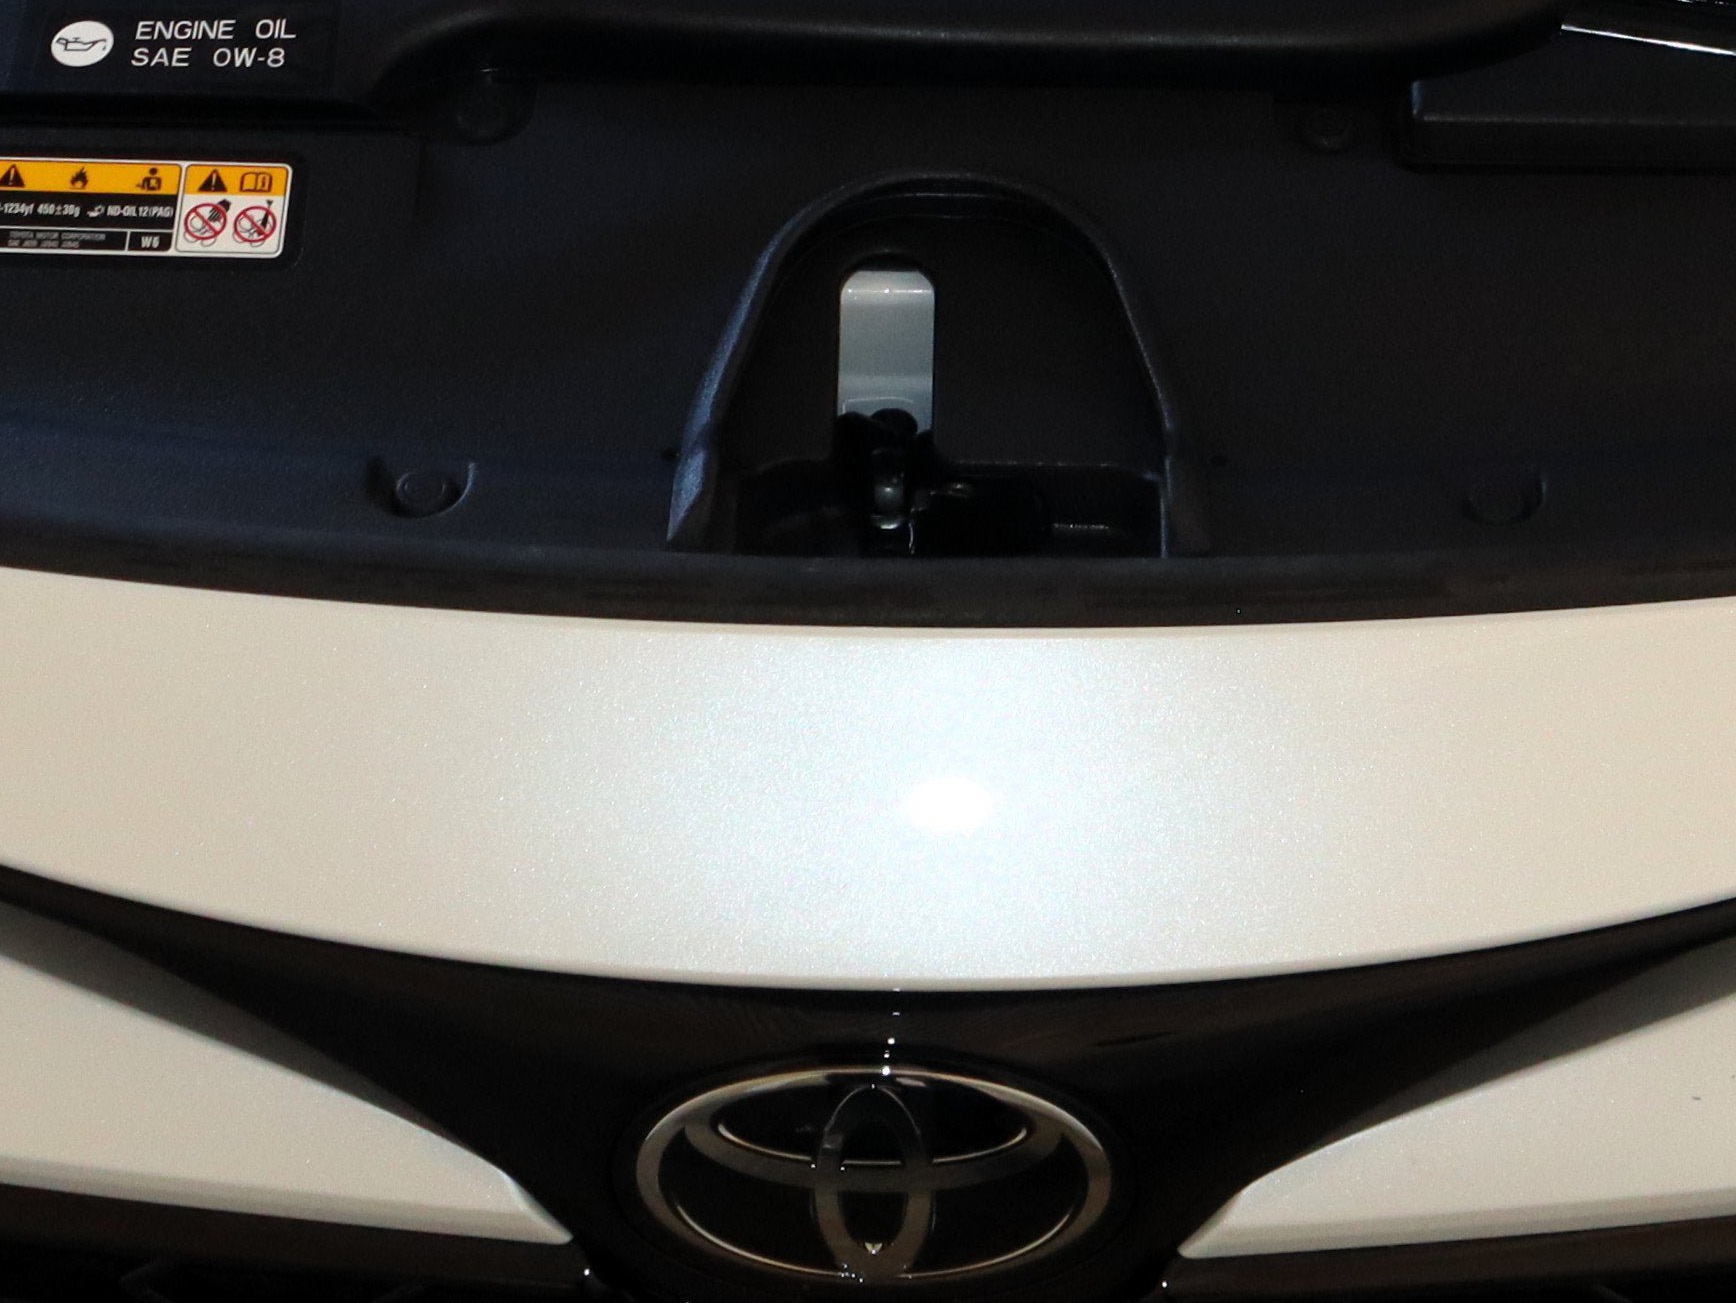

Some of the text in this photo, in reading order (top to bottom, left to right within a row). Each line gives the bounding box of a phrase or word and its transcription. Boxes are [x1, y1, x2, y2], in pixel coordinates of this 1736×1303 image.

[135, 18, 297, 40] ENGINE OIL
[130, 47, 286, 68] SAE 0W-8
